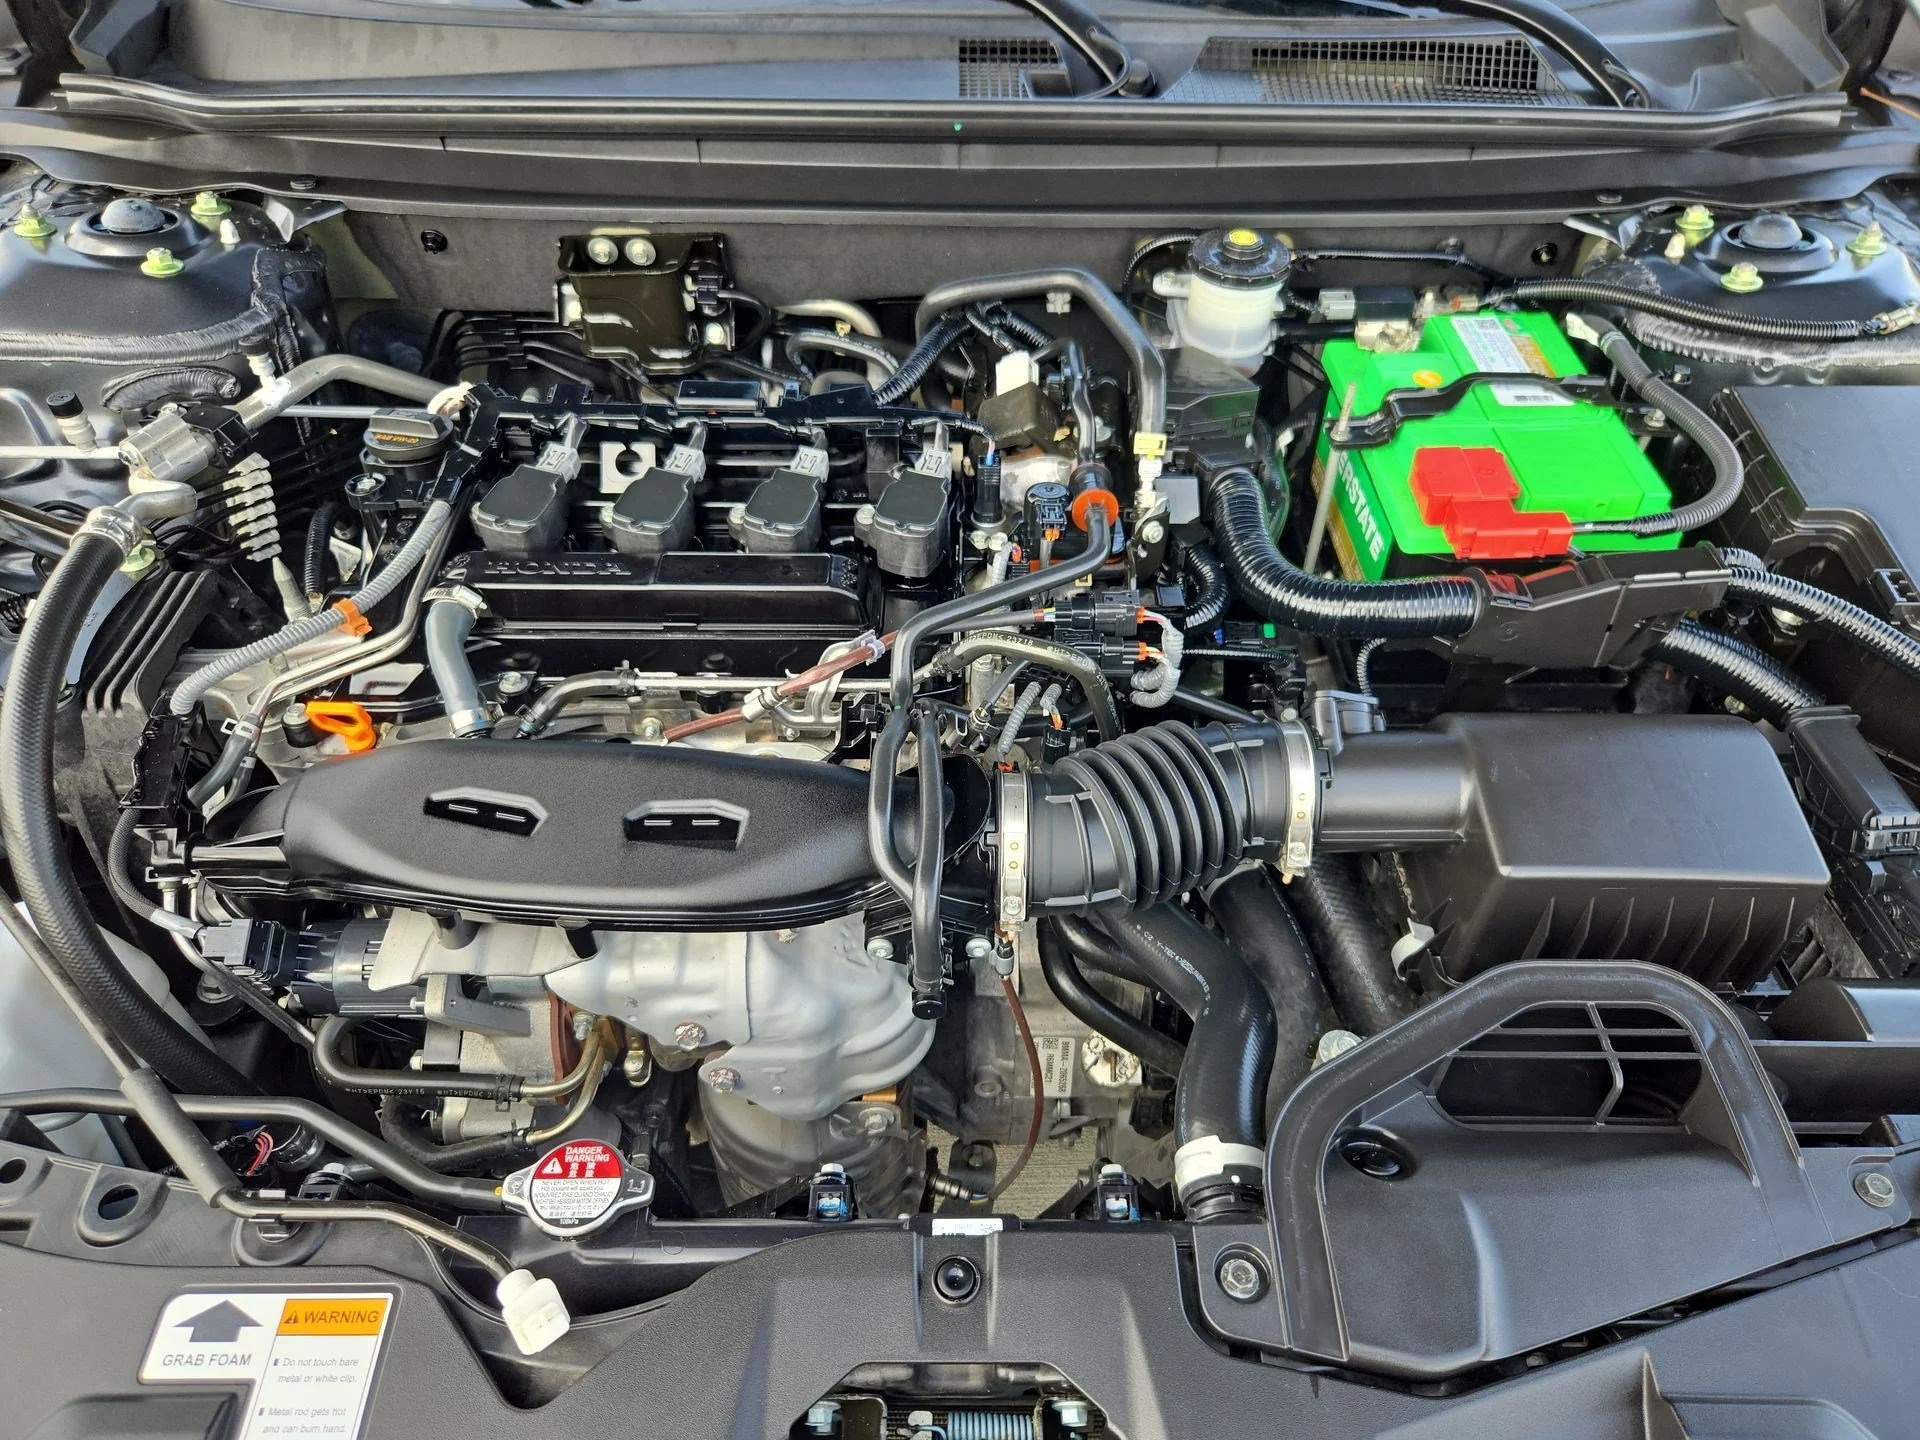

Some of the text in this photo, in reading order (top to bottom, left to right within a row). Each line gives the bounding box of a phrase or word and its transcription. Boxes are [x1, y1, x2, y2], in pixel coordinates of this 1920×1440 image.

[1338, 450, 1385, 563] ERSTATE
[485, 560, 632, 575] HONDA
[565, 1146, 603, 1155] DANGER
[564, 1154, 610, 1163] WARNUNG
[303, 1310, 381, 1324] WARNING
[163, 1353, 253, 1367] GRAB FOAM
[282, 1358, 359, 1366] Do not touch bare
[278, 1375, 302, 1383] metal
[303, 1376, 313, 1384] or
[314, 1375, 338, 1383] white
[268, 1407, 347, 1418] Metal rod gets hot
[262, 1425, 281, 1433] and
[300, 1425, 321, 1433] burn
